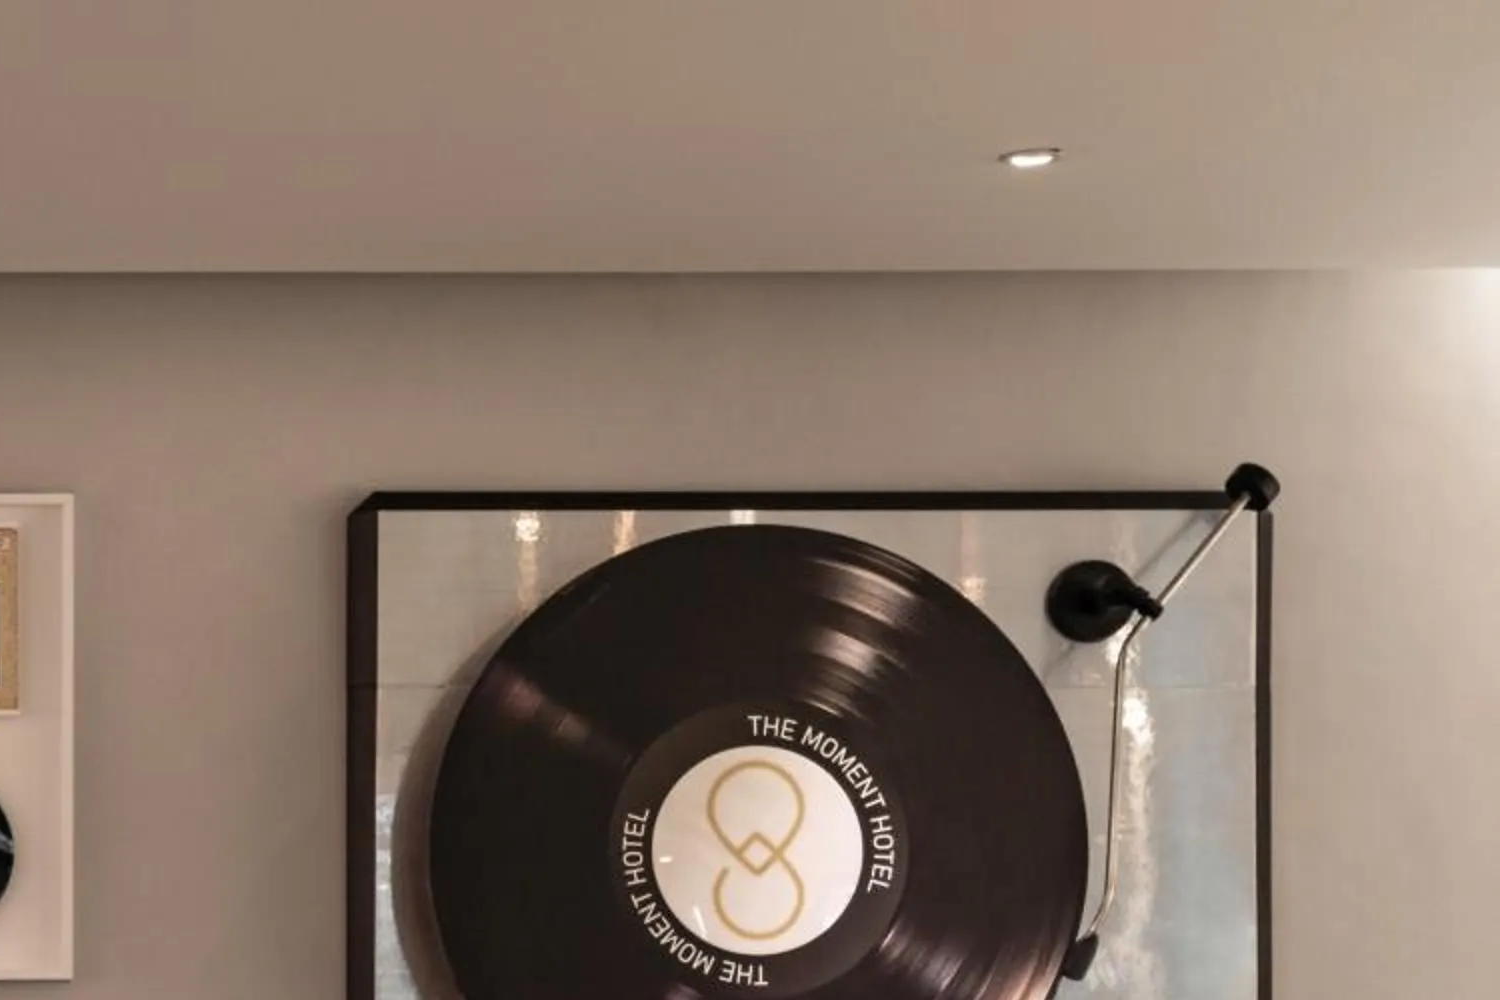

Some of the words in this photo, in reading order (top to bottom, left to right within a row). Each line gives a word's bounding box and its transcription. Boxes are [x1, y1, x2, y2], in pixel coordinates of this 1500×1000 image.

[748, 714, 798, 741] THE
[801, 727, 887, 812] MOMENT
[867, 815, 895, 893] HOTEL
[622, 808, 651, 886] HOTEL
[631, 893, 716, 976] MOMENT
[719, 959, 769, 987] THE
